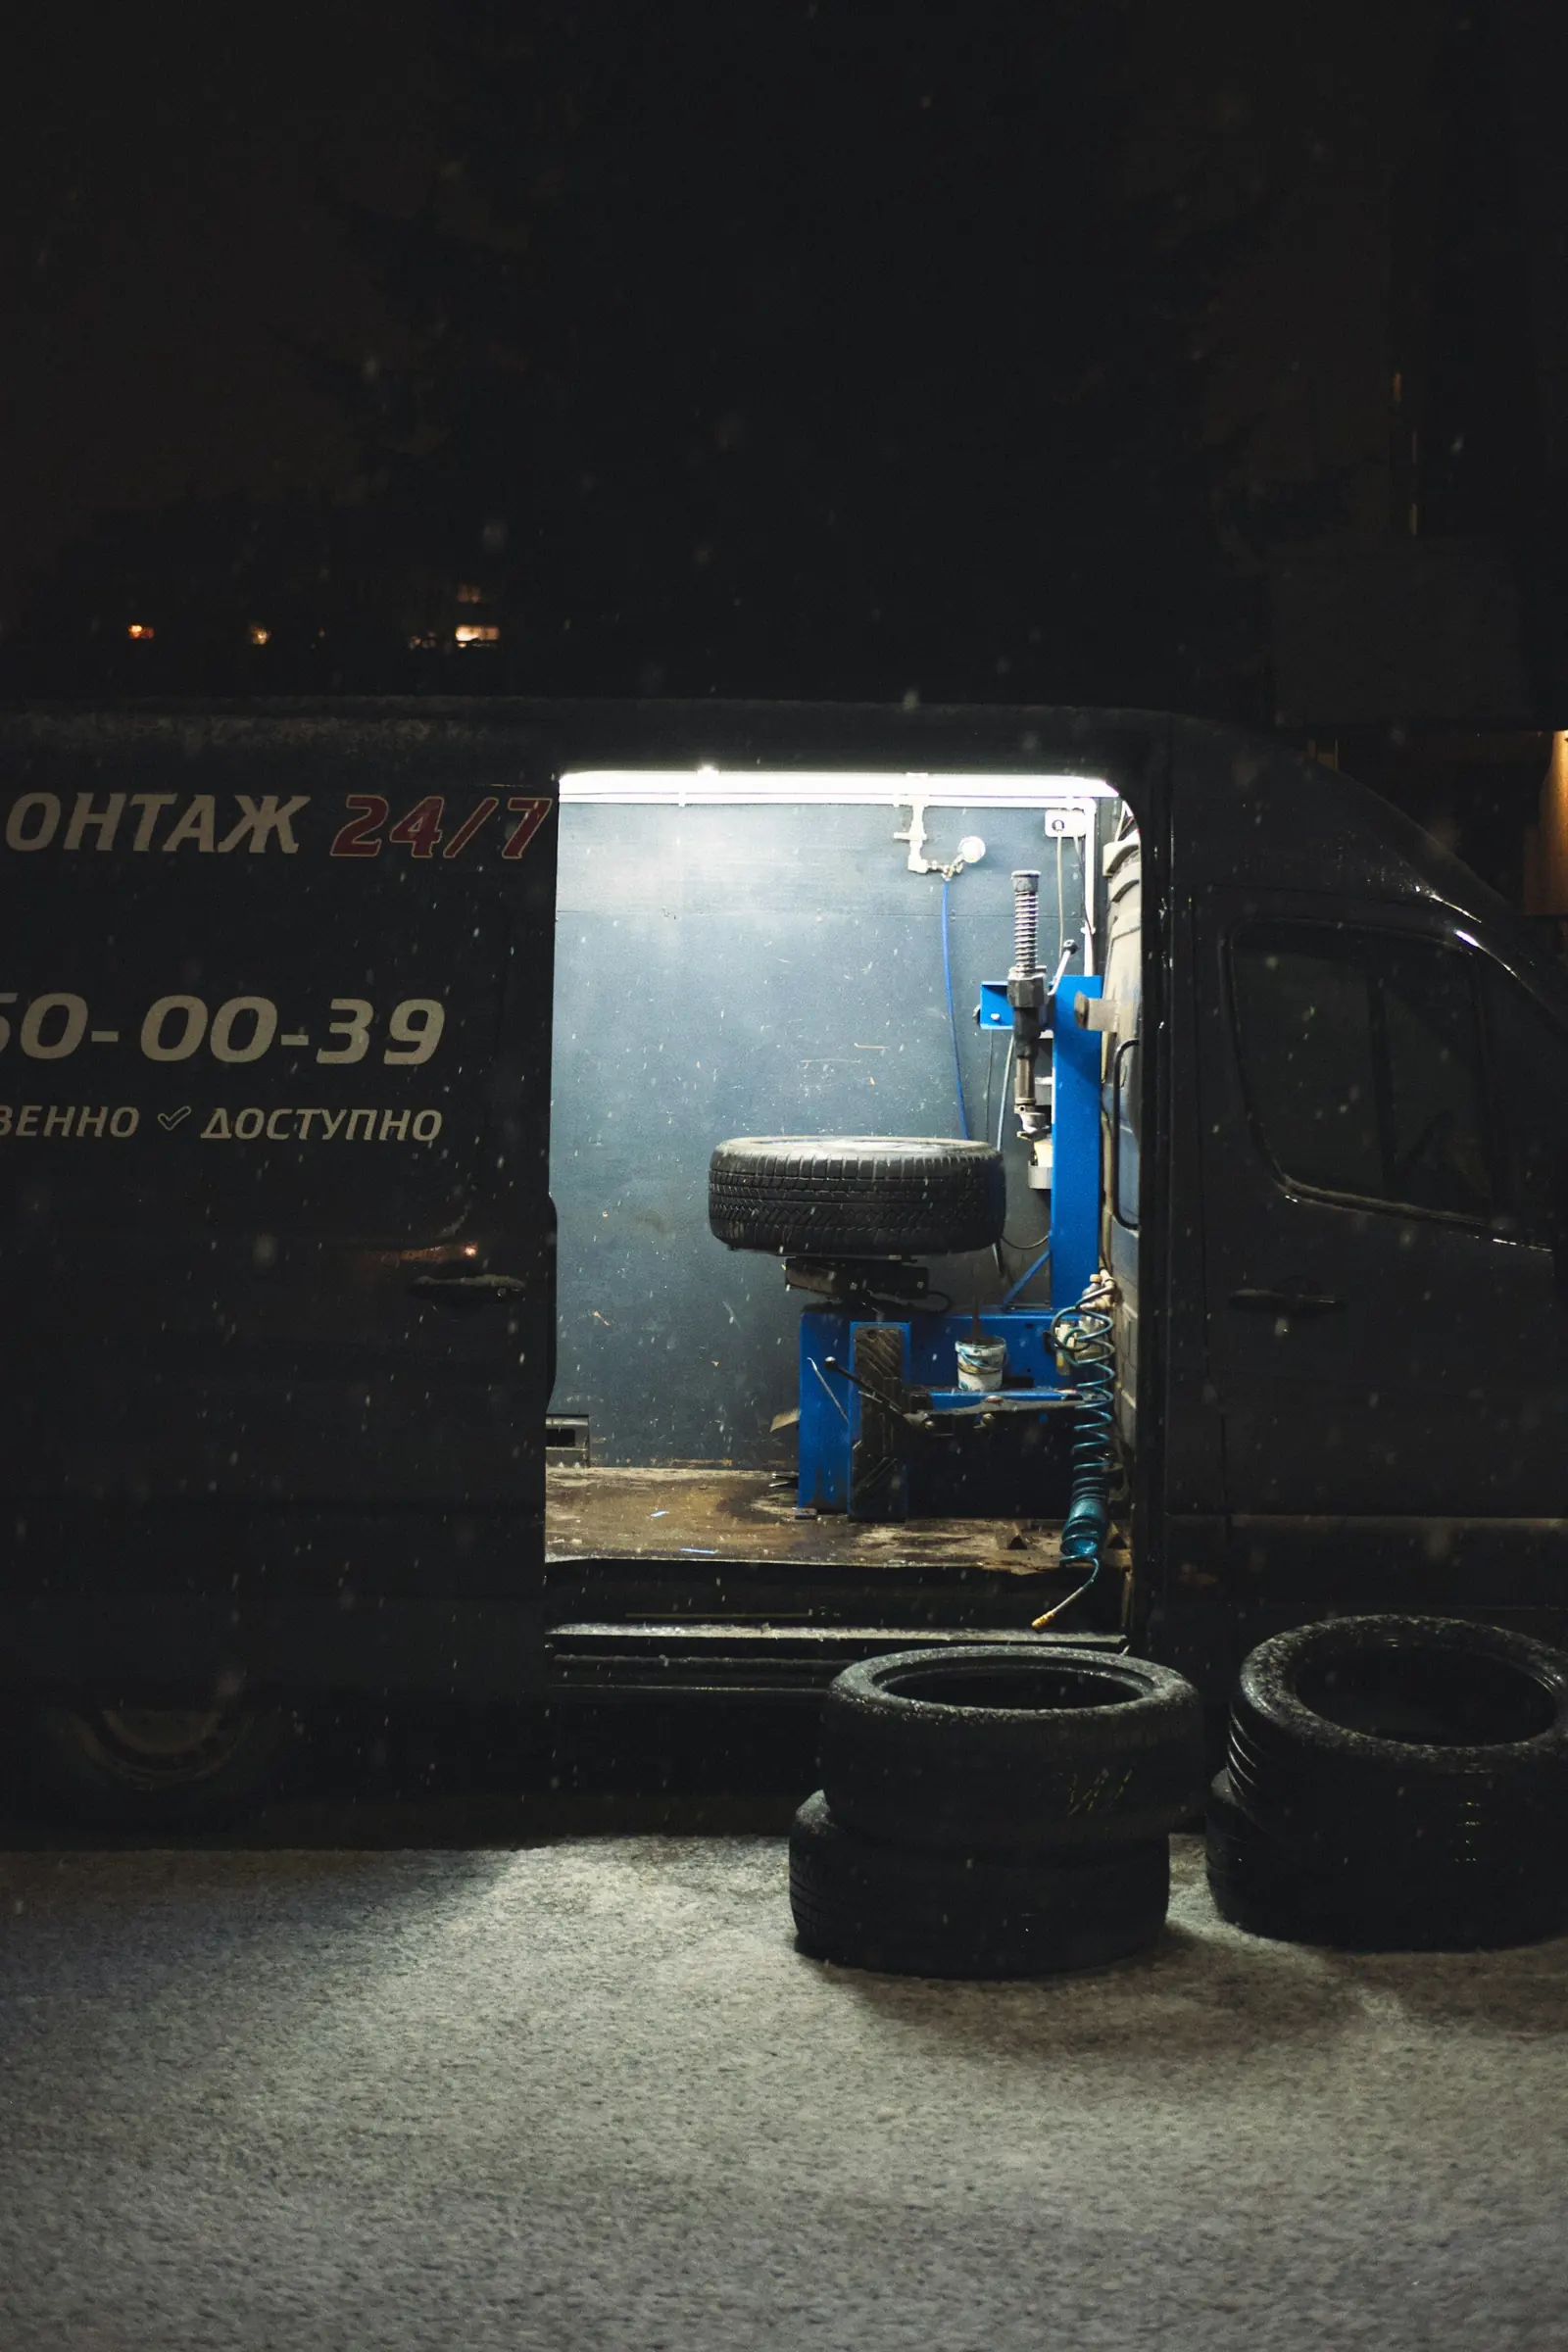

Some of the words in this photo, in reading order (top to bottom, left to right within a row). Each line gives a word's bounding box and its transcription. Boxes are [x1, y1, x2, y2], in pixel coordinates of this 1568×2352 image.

[5, 792, 312, 855] ОНТАЖ
[329, 794, 553, 859] 24/7
[199, 1106, 443, 1142] ДОСТУПНО
